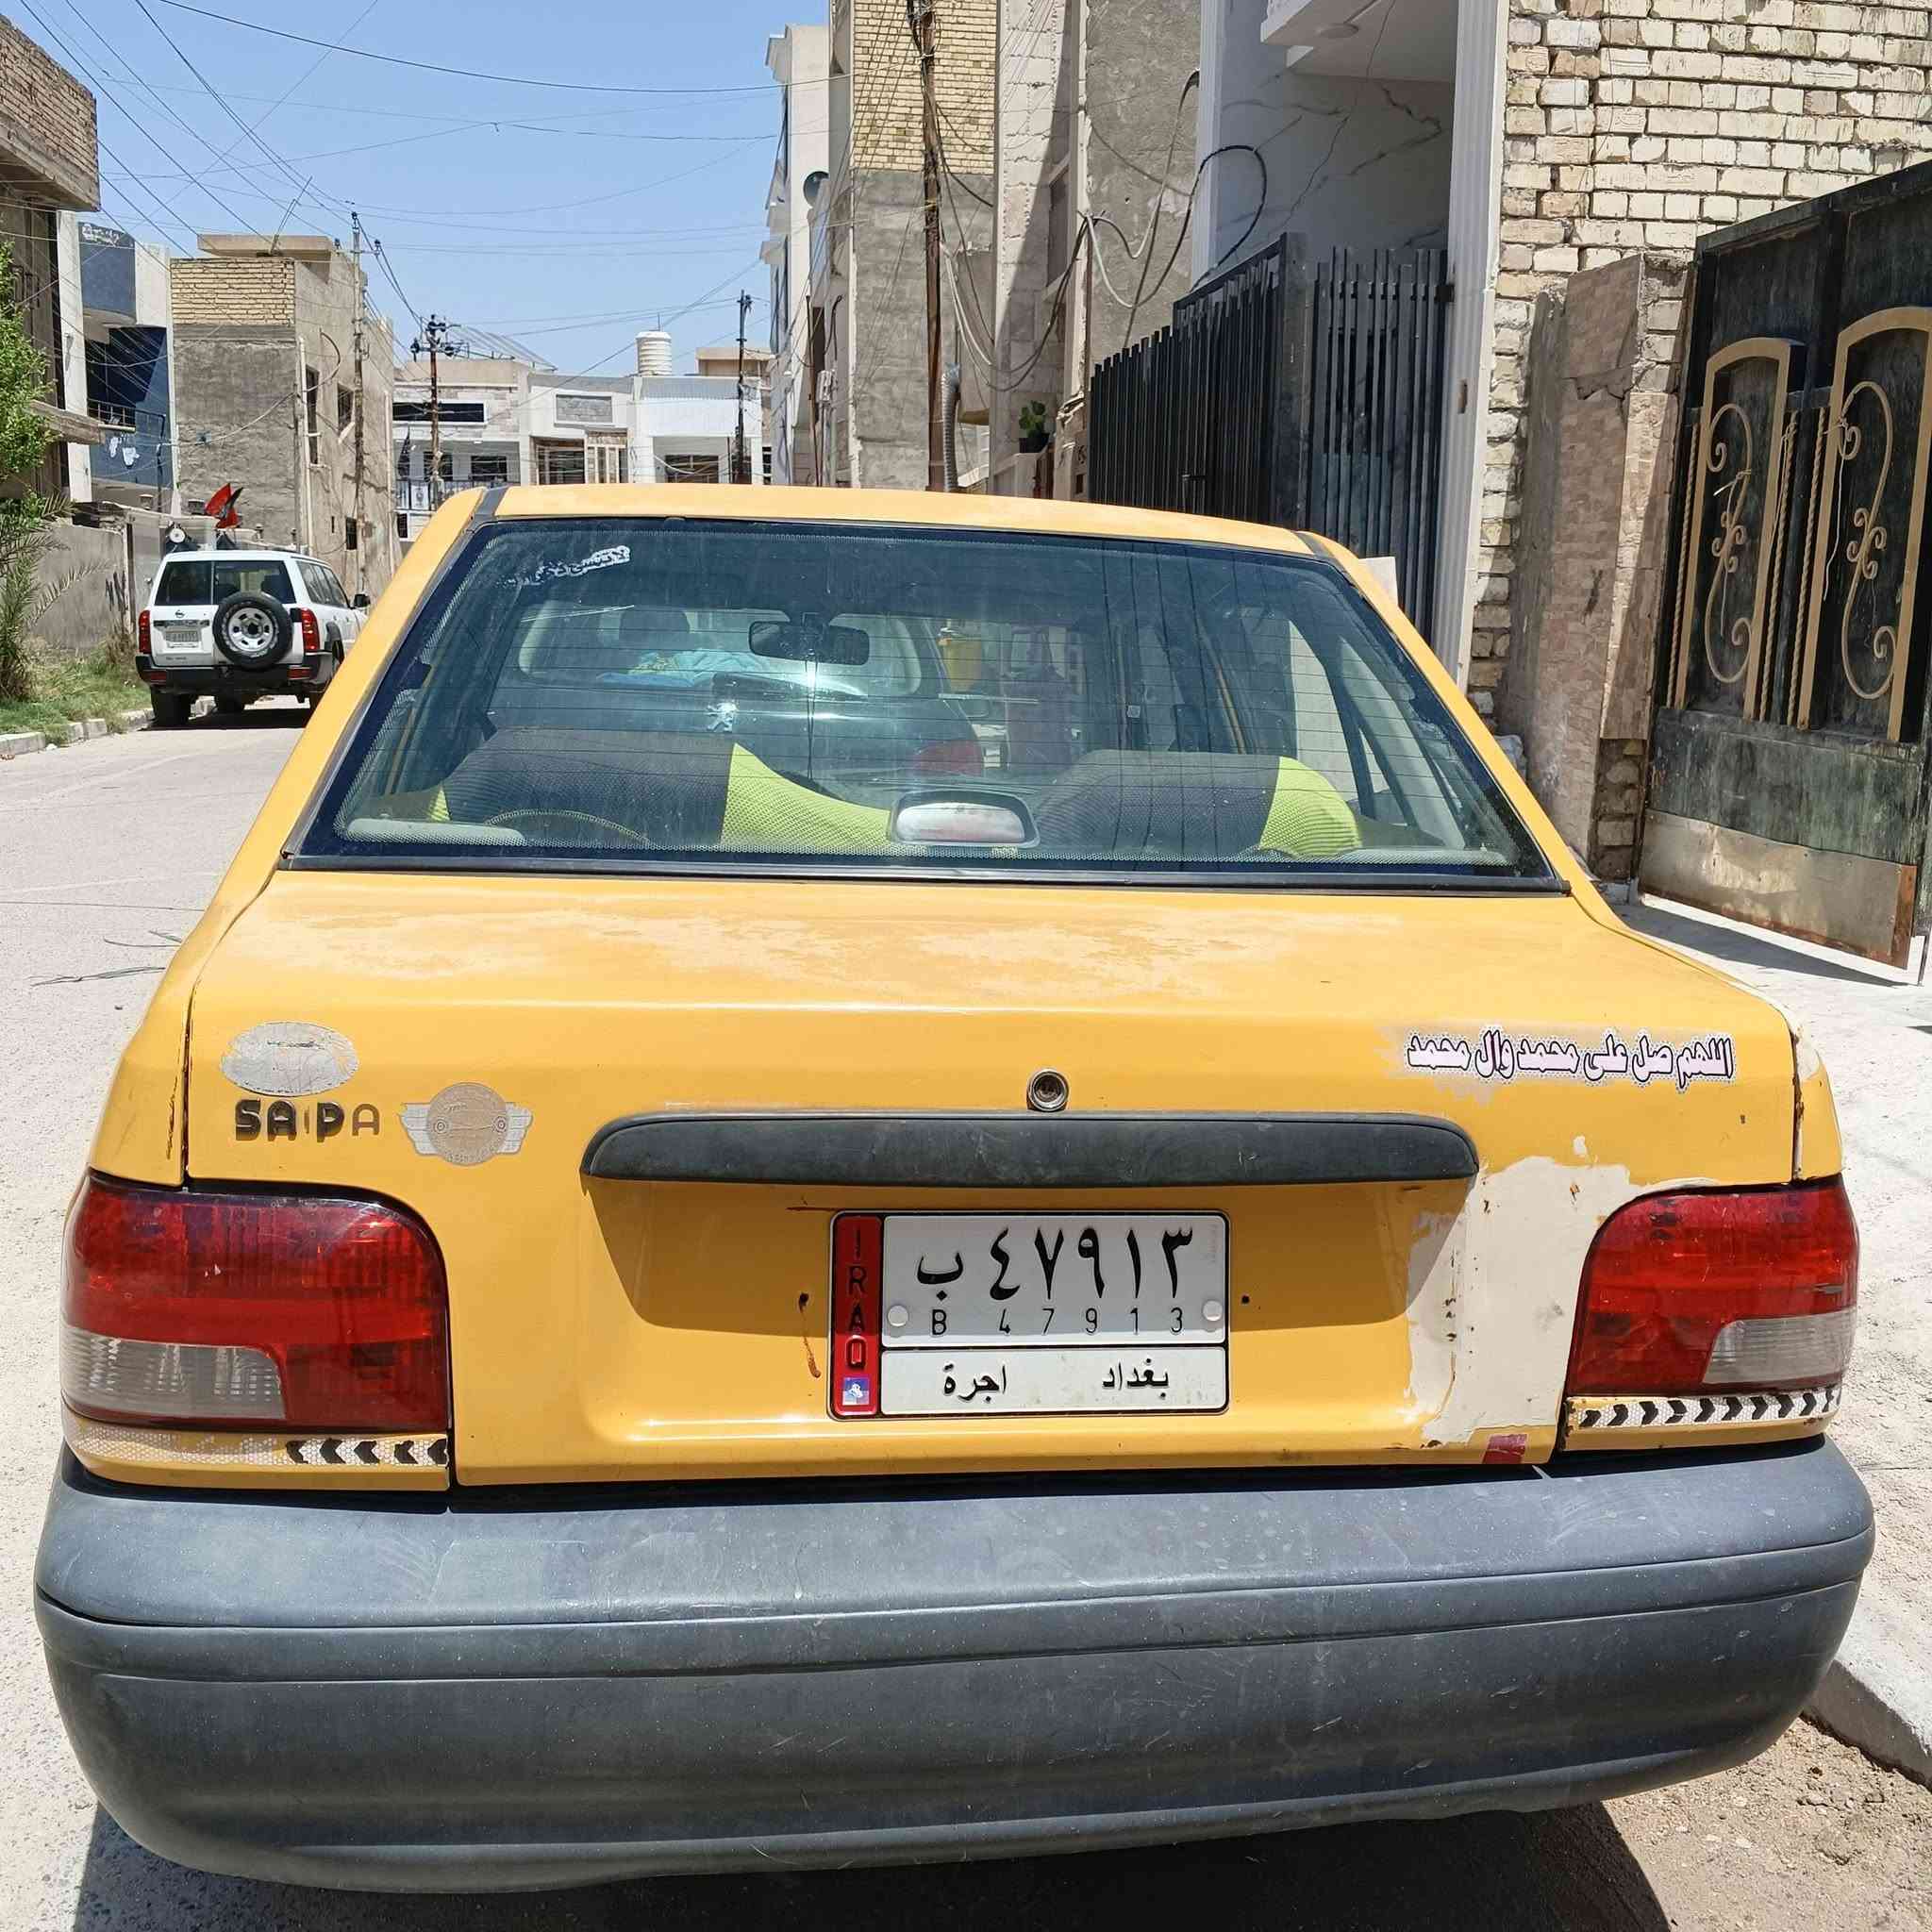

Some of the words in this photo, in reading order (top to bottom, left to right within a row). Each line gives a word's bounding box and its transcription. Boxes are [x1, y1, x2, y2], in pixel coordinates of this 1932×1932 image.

[1407, 1035, 1472, 1070] محمد
[1474, 1029, 1515, 1078] وال
[1517, 1038, 1580, 1074] محمد
[1631, 1035, 1674, 1082] صل
[1676, 1037, 1734, 1089] اللهم
[235, 1098, 381, 1143] SAIPA
[844, 1228, 868, 1370] IRAQ
[942, 1360, 1008, 1404] اجرة
[1101, 1357, 1170, 1400] بغداد
